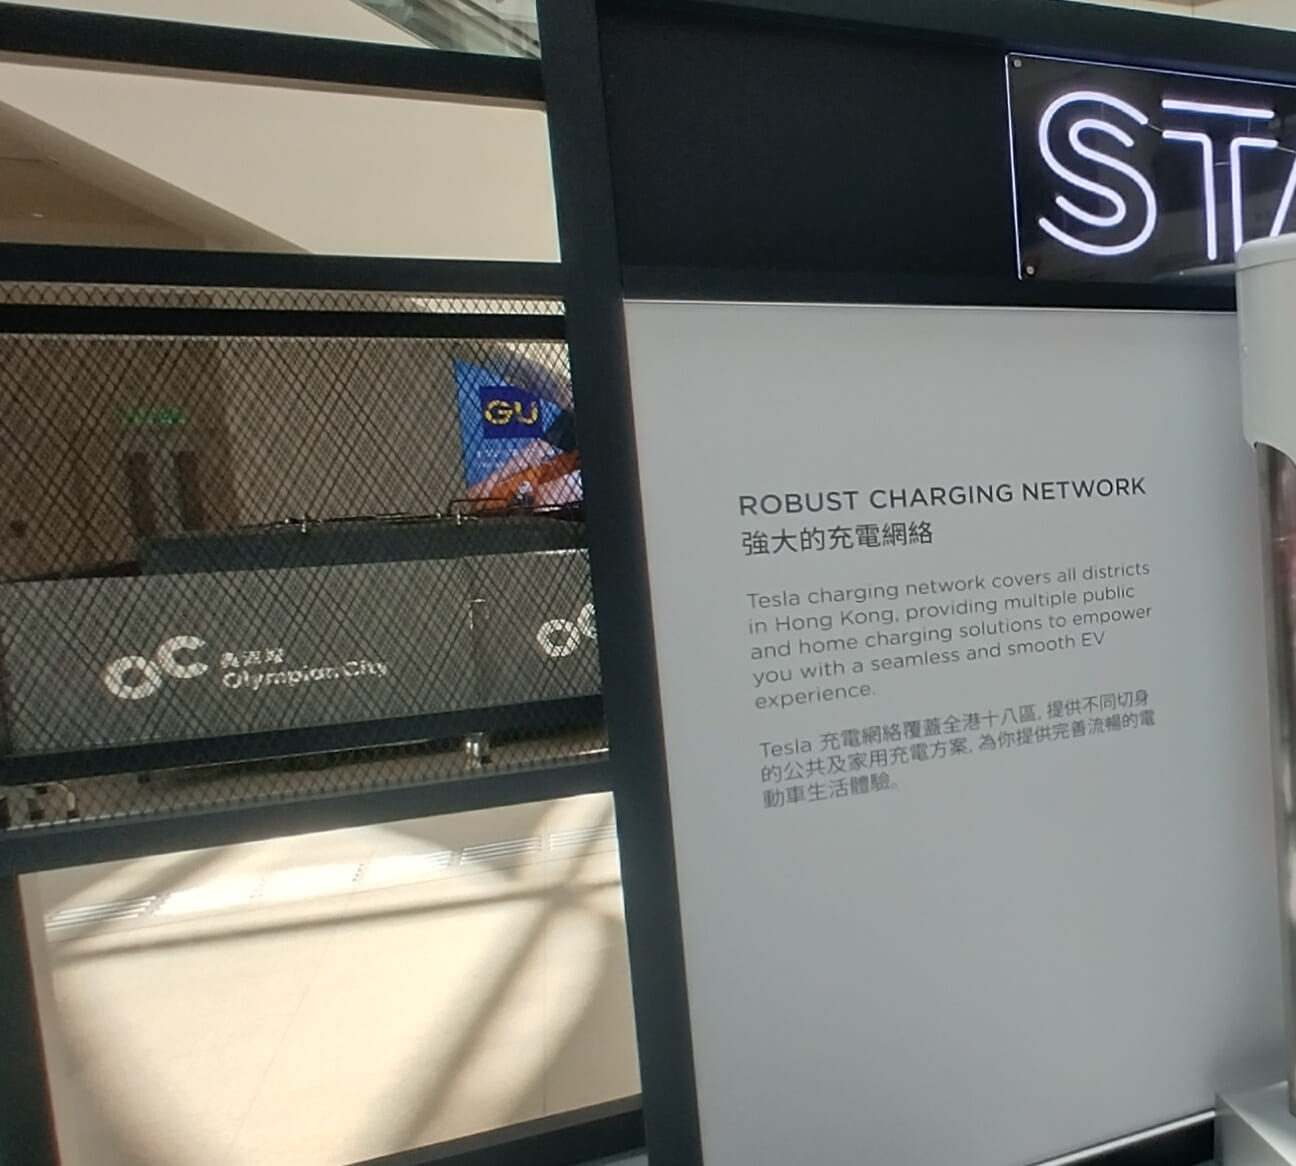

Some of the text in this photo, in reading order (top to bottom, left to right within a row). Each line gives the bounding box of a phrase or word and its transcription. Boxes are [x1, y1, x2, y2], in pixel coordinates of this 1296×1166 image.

[484, 399, 539, 425] GU
[739, 477, 1147, 516] ROBUST CHARGING NETWORK
[741, 520, 933, 556] 強大的充電網絡
[746, 562, 1151, 609] Tesla charging network covers all districts
[748, 585, 1135, 635] in Hong Kong, providing multiple public
[751, 606, 1152, 660] and home charging solutions to empower
[753, 631, 1105, 688] you with a seamless and smooth EV
[755, 683, 877, 710] experience.
[760, 738, 812, 759] Tesla
